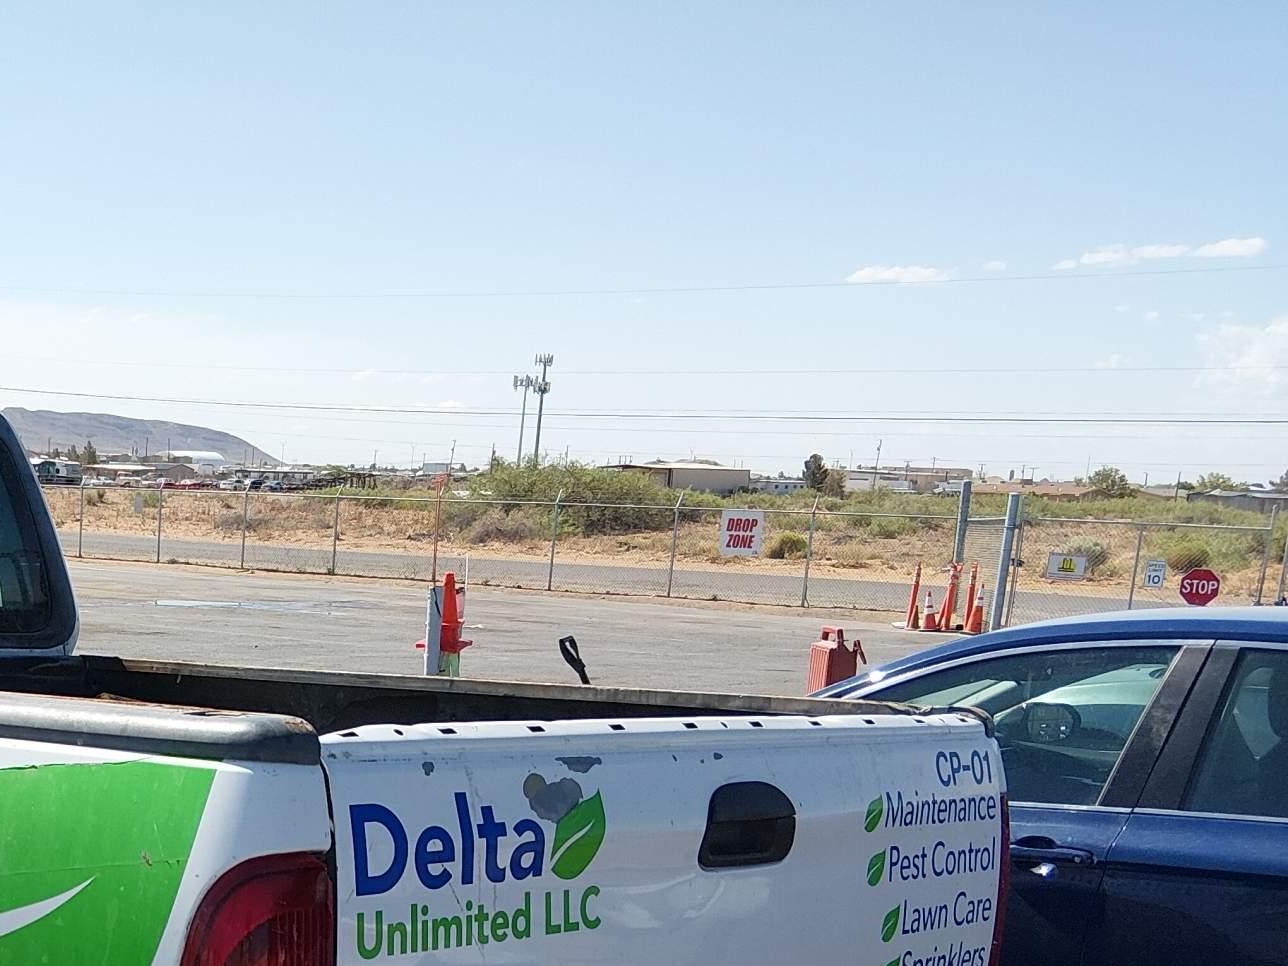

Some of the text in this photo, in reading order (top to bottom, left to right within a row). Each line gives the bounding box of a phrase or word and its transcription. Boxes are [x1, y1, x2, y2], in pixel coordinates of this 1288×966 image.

[726, 518, 758, 532] DROP
[726, 534, 755, 548] ZONE
[1147, 574, 1161, 584] 10
[1182, 580, 1218, 595] STOP
[935, 750, 992, 787] CP-01
[885, 789, 996, 828] Maintenance
[349, 792, 545, 897] Delta
[889, 836, 996, 882] Pest Control
[356, 885, 601, 960] Unlimited LLC
[901, 891, 991, 935] Lawn Care
